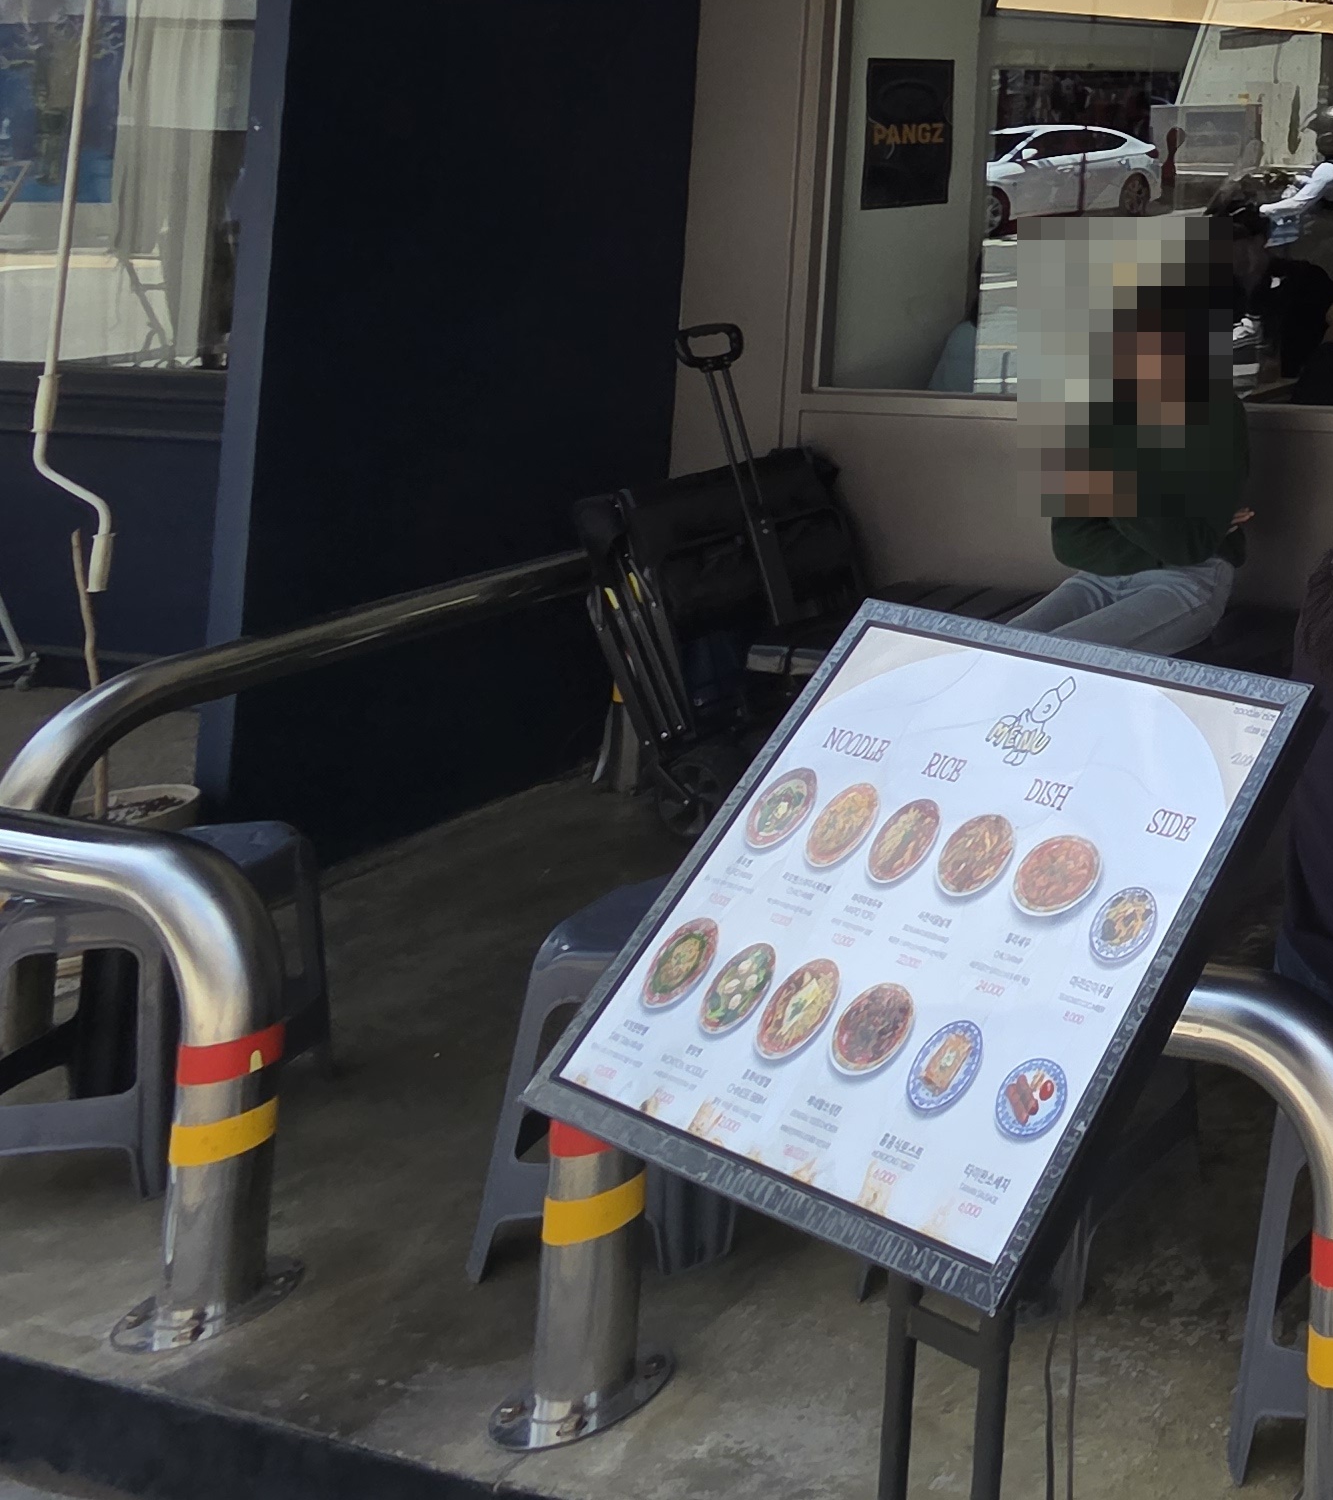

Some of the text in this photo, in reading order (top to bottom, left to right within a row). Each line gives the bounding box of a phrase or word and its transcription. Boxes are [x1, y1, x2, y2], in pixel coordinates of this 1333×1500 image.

[872, 123, 945, 145] PANGZ
[823, 727, 891, 762] NOODLE
[985, 721, 1051, 755] MENU
[921, 752, 967, 783] RICE
[1024, 778, 1075, 811] DISH
[1146, 808, 1197, 841] SIDE
[974, 979, 1006, 997] 24,000
